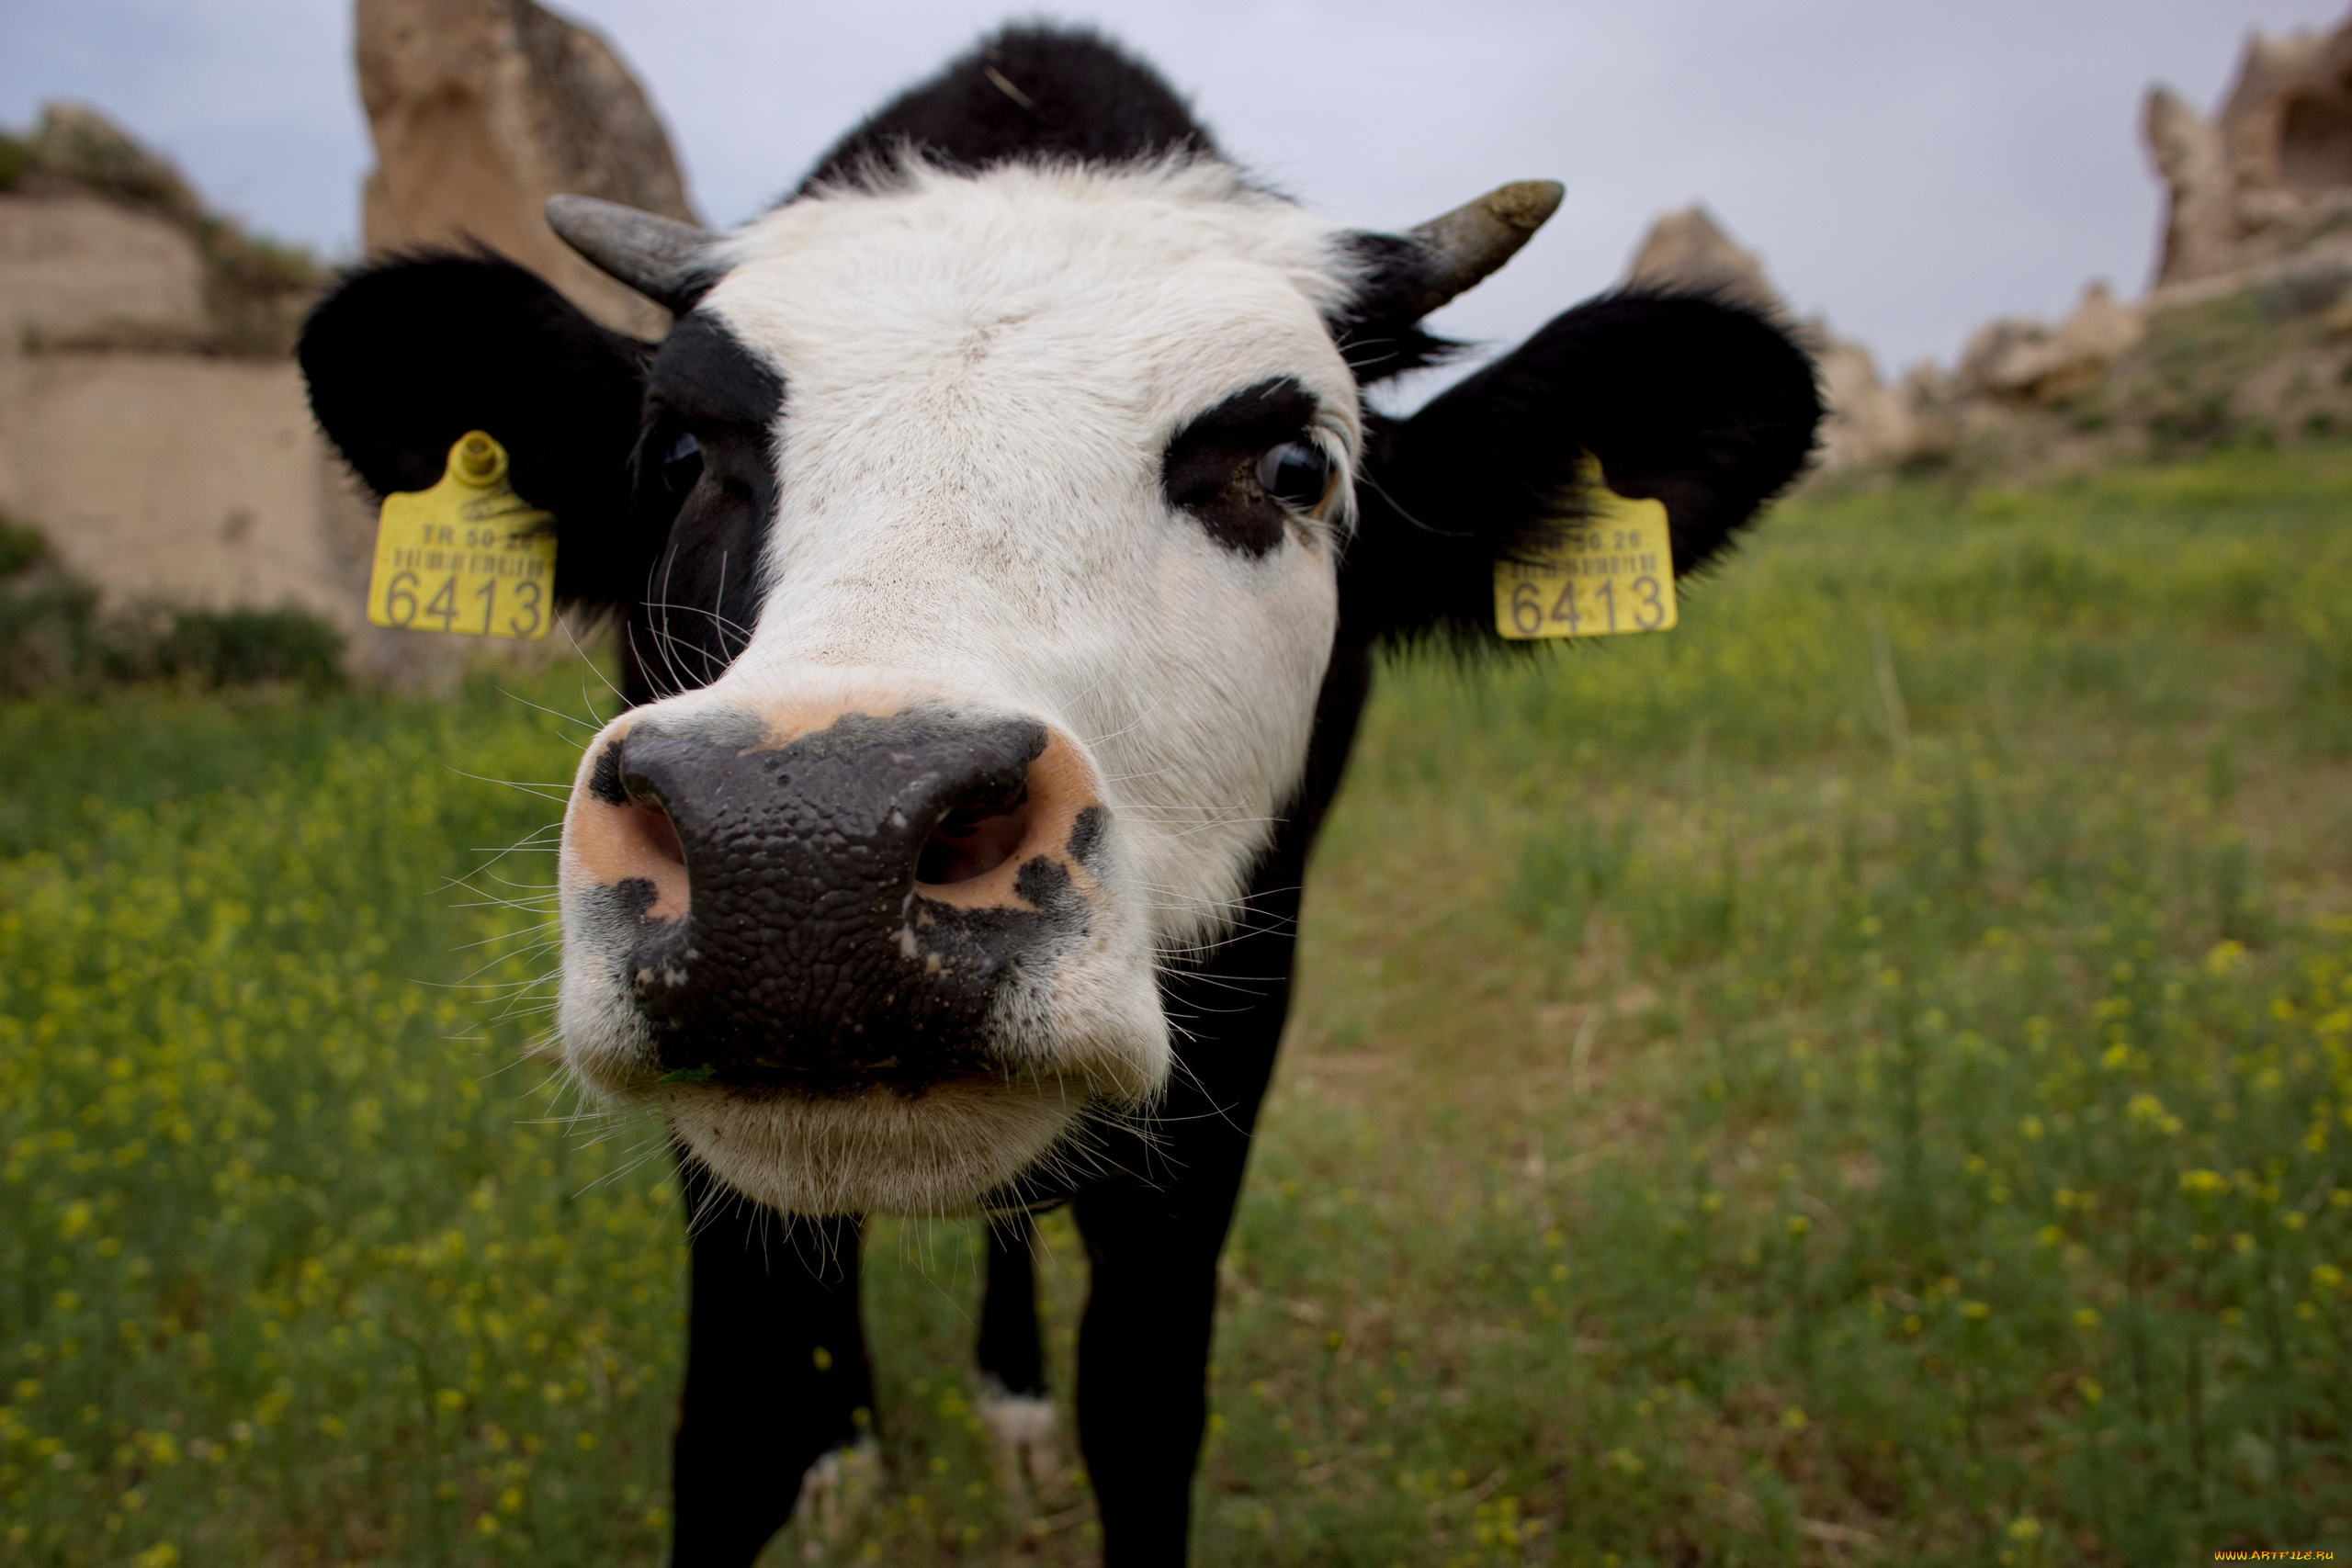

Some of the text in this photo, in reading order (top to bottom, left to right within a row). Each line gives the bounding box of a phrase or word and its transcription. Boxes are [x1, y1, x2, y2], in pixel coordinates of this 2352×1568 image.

[422, 523, 455, 546] TR
[386, 570, 542, 636] 6413
[1511, 575, 1665, 636] 6413
